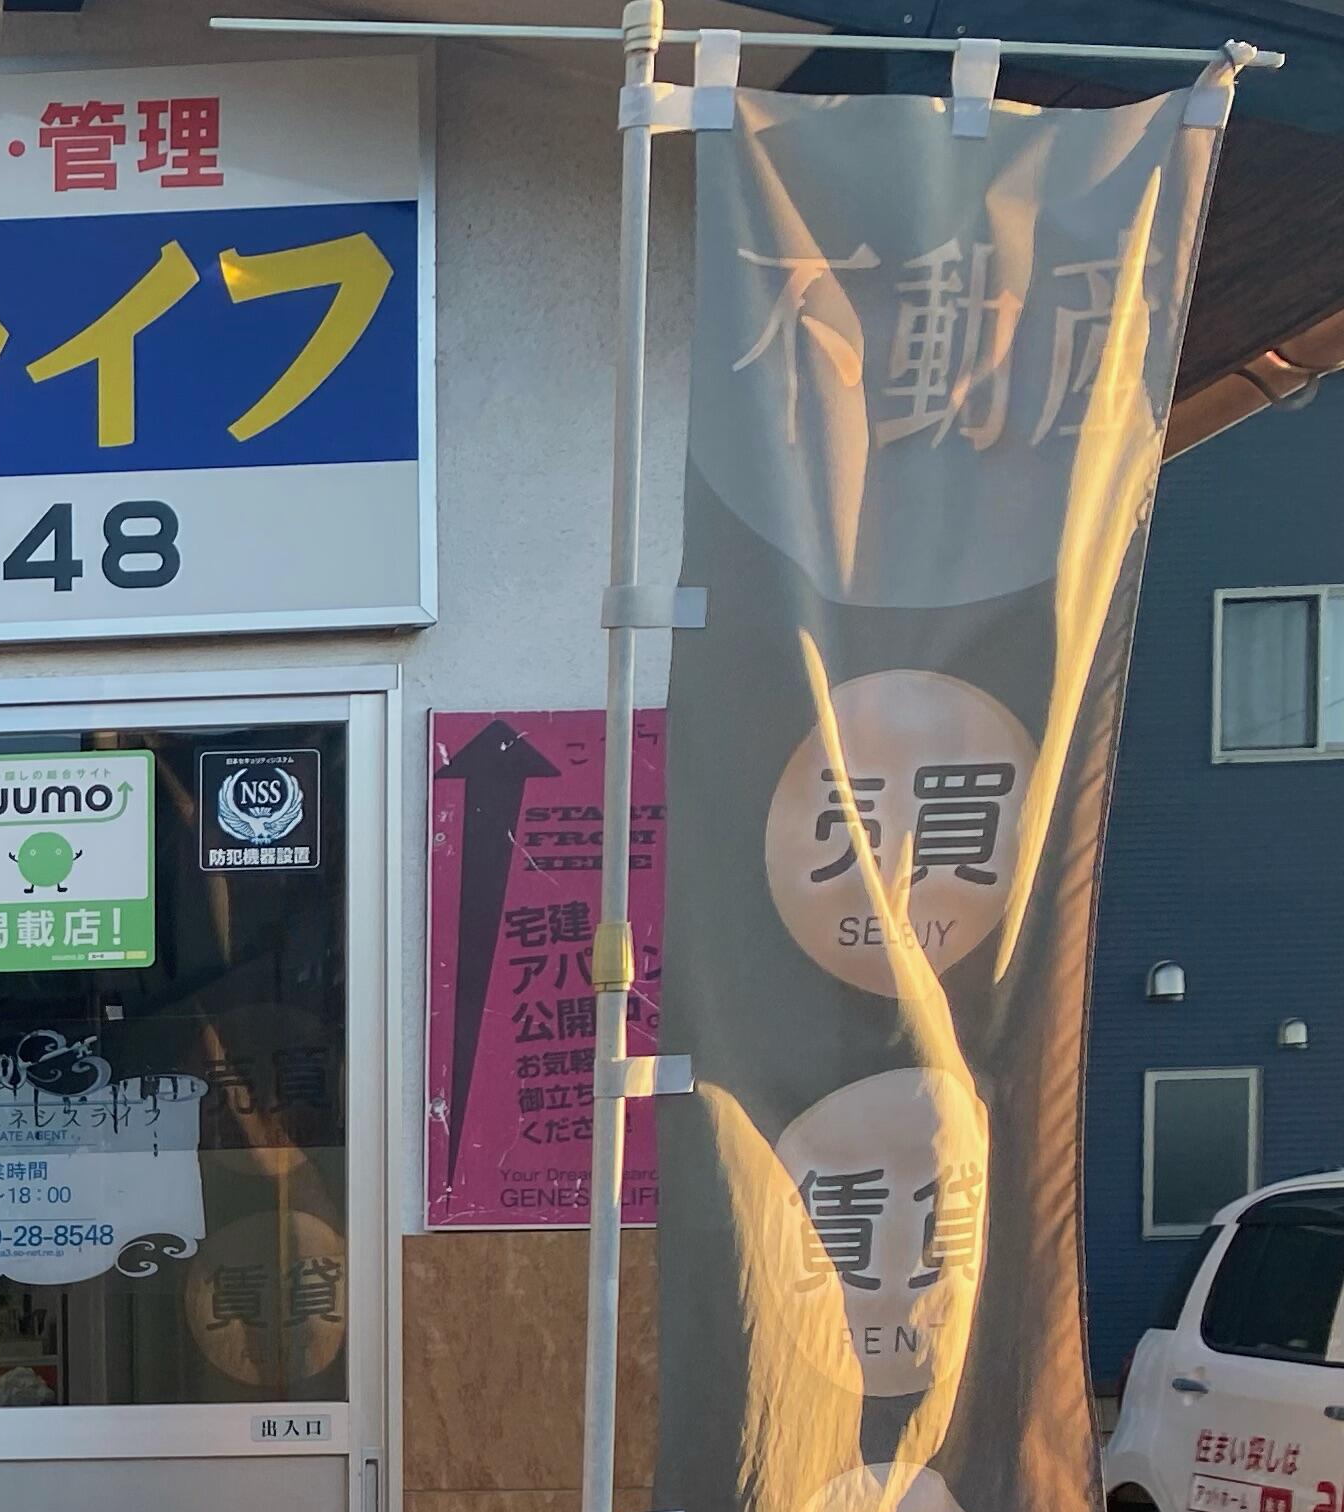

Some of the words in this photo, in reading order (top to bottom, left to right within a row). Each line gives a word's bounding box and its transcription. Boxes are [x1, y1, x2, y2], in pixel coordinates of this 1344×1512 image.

[240, 779, 282, 805] NSS
[810, 762, 1017, 886] 売買
[208, 845, 311, 867] 防犯機器設置
[504, 900, 594, 949] 宅建
[500, 1168, 540, 1182] Your
[788, 1161, 983, 1294] 賃貸
[260, 1417, 322, 1439] 出入口
